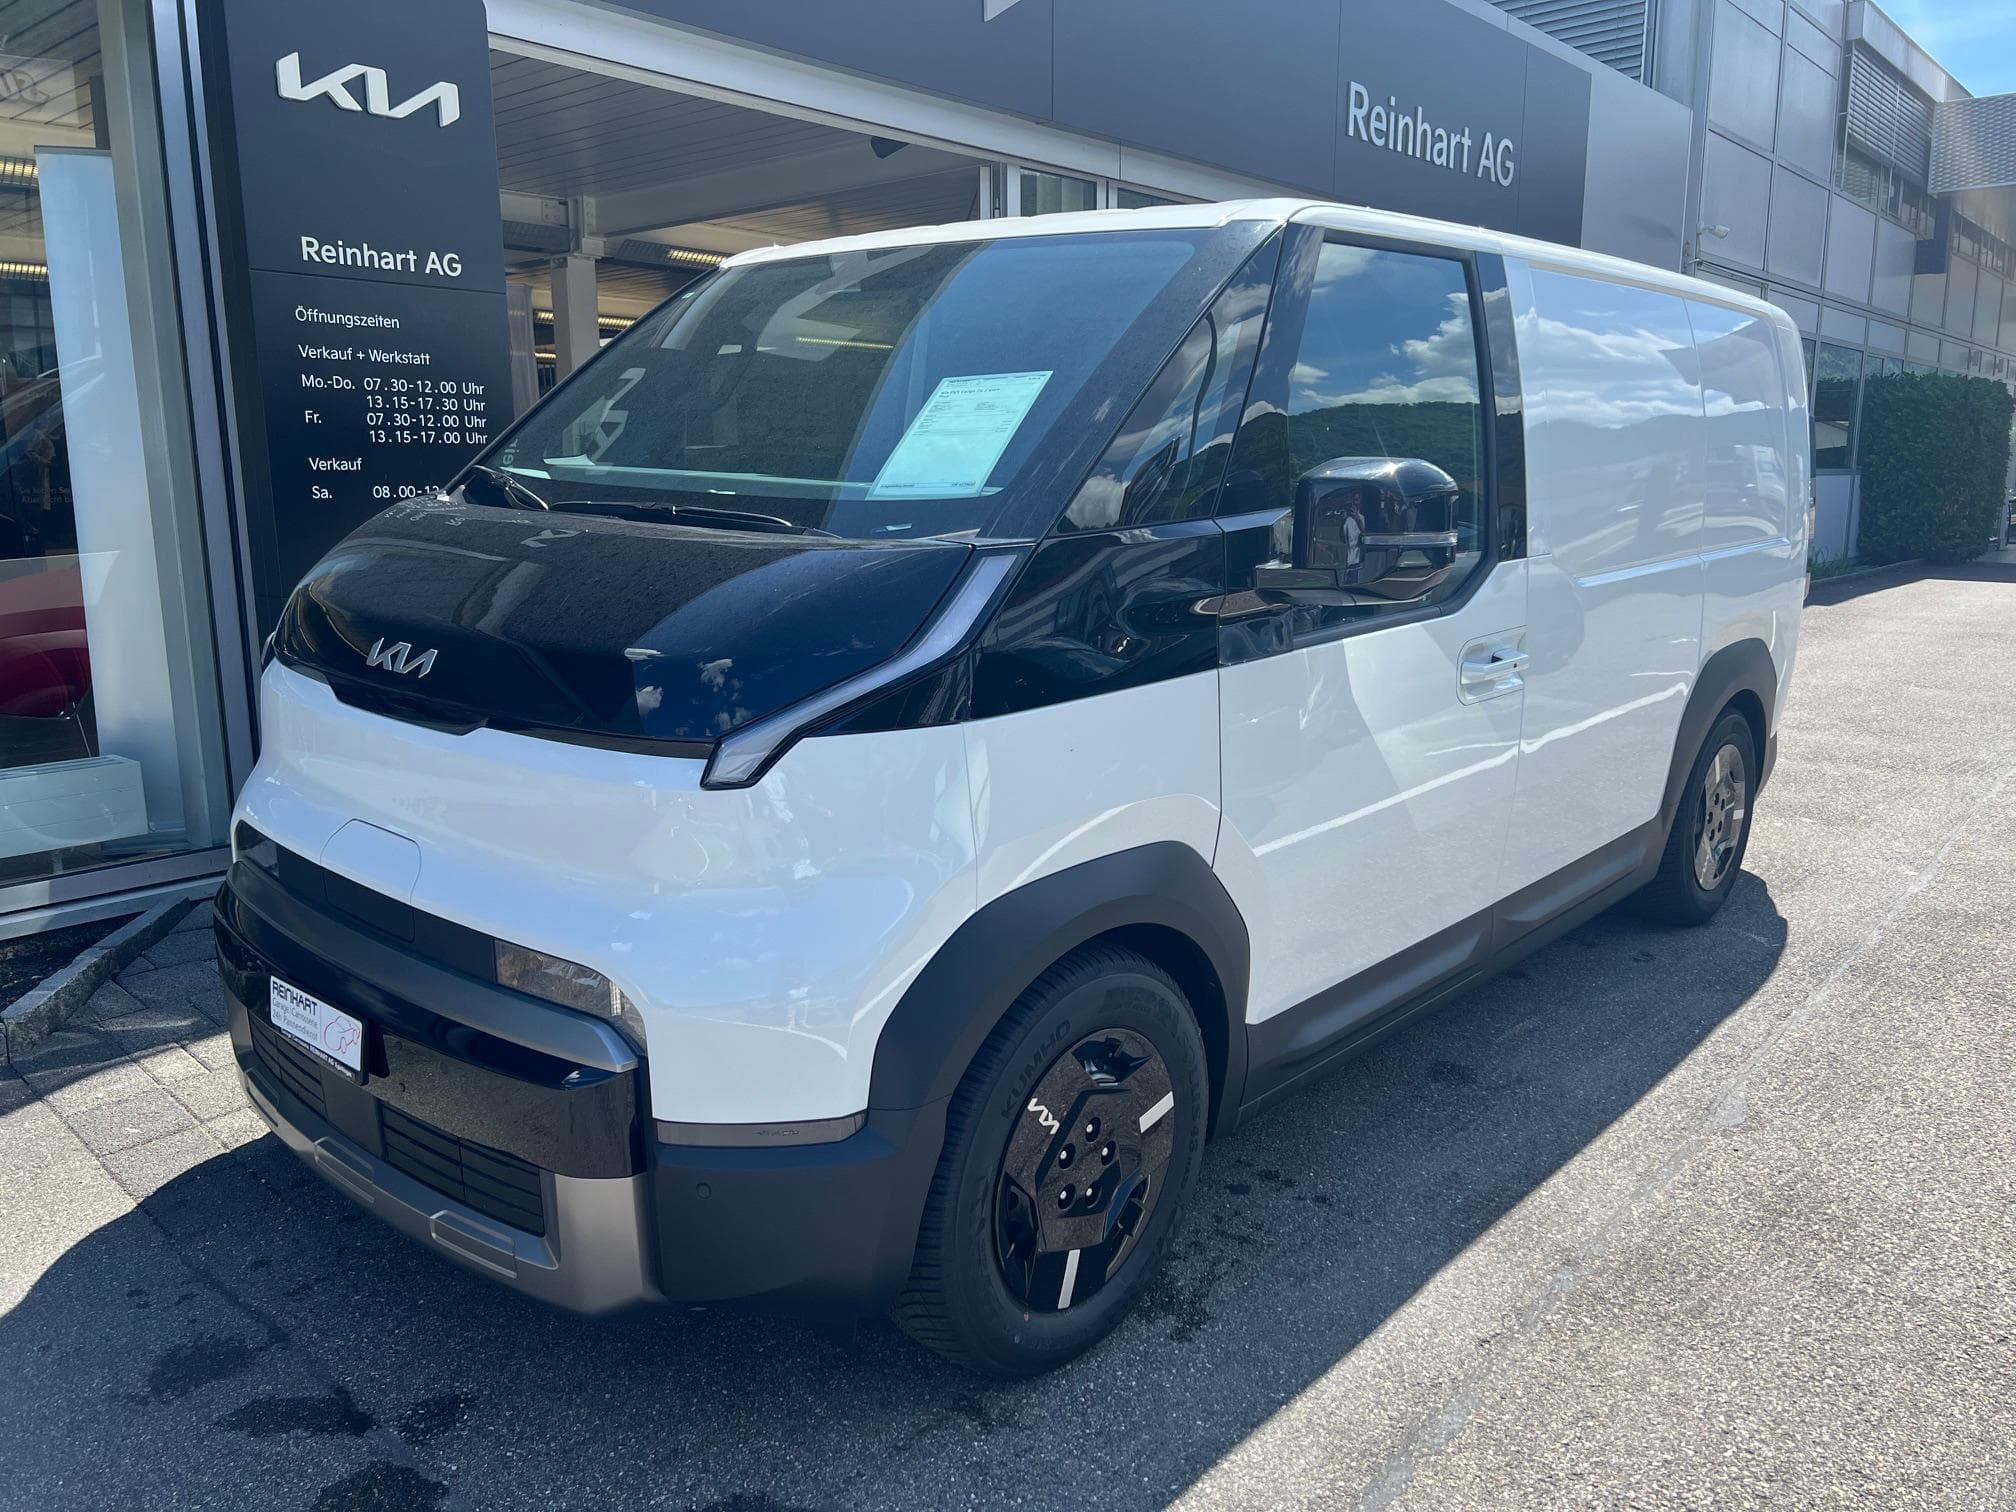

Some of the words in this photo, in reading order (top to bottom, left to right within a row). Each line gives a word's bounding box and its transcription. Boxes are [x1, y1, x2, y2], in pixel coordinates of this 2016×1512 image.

[1348, 80, 1472, 173] Reinhart
[1477, 132, 1515, 187] AG
[301, 236, 417, 272] Reinhart
[425, 252, 462, 277] AG
[295, 305, 400, 329] Öffnungszeiten
[298, 345, 353, 361] Verkauf
[357, 351, 366, 361] +
[369, 349, 431, 365] Werkstatt
[301, 374, 356, 390] Mo.-Do.
[364, 378, 457, 393] 07.30-12.00
[462, 382, 485, 395] Uhr
[366, 395, 458, 411] 13.15-17.30
[464, 399, 486, 412] Uhr
[305, 410, 322, 424] Fr.
[367, 413, 459, 428] 07.30-12.00
[465, 416, 487, 428] Uhr
[370, 430, 461, 445] 13.15-17.00
[466, 432, 488, 445] Uhr
[309, 457, 363, 471] Verkauf
[312, 486, 333, 499] Sa.
[272, 980, 318, 1017] REINHART
